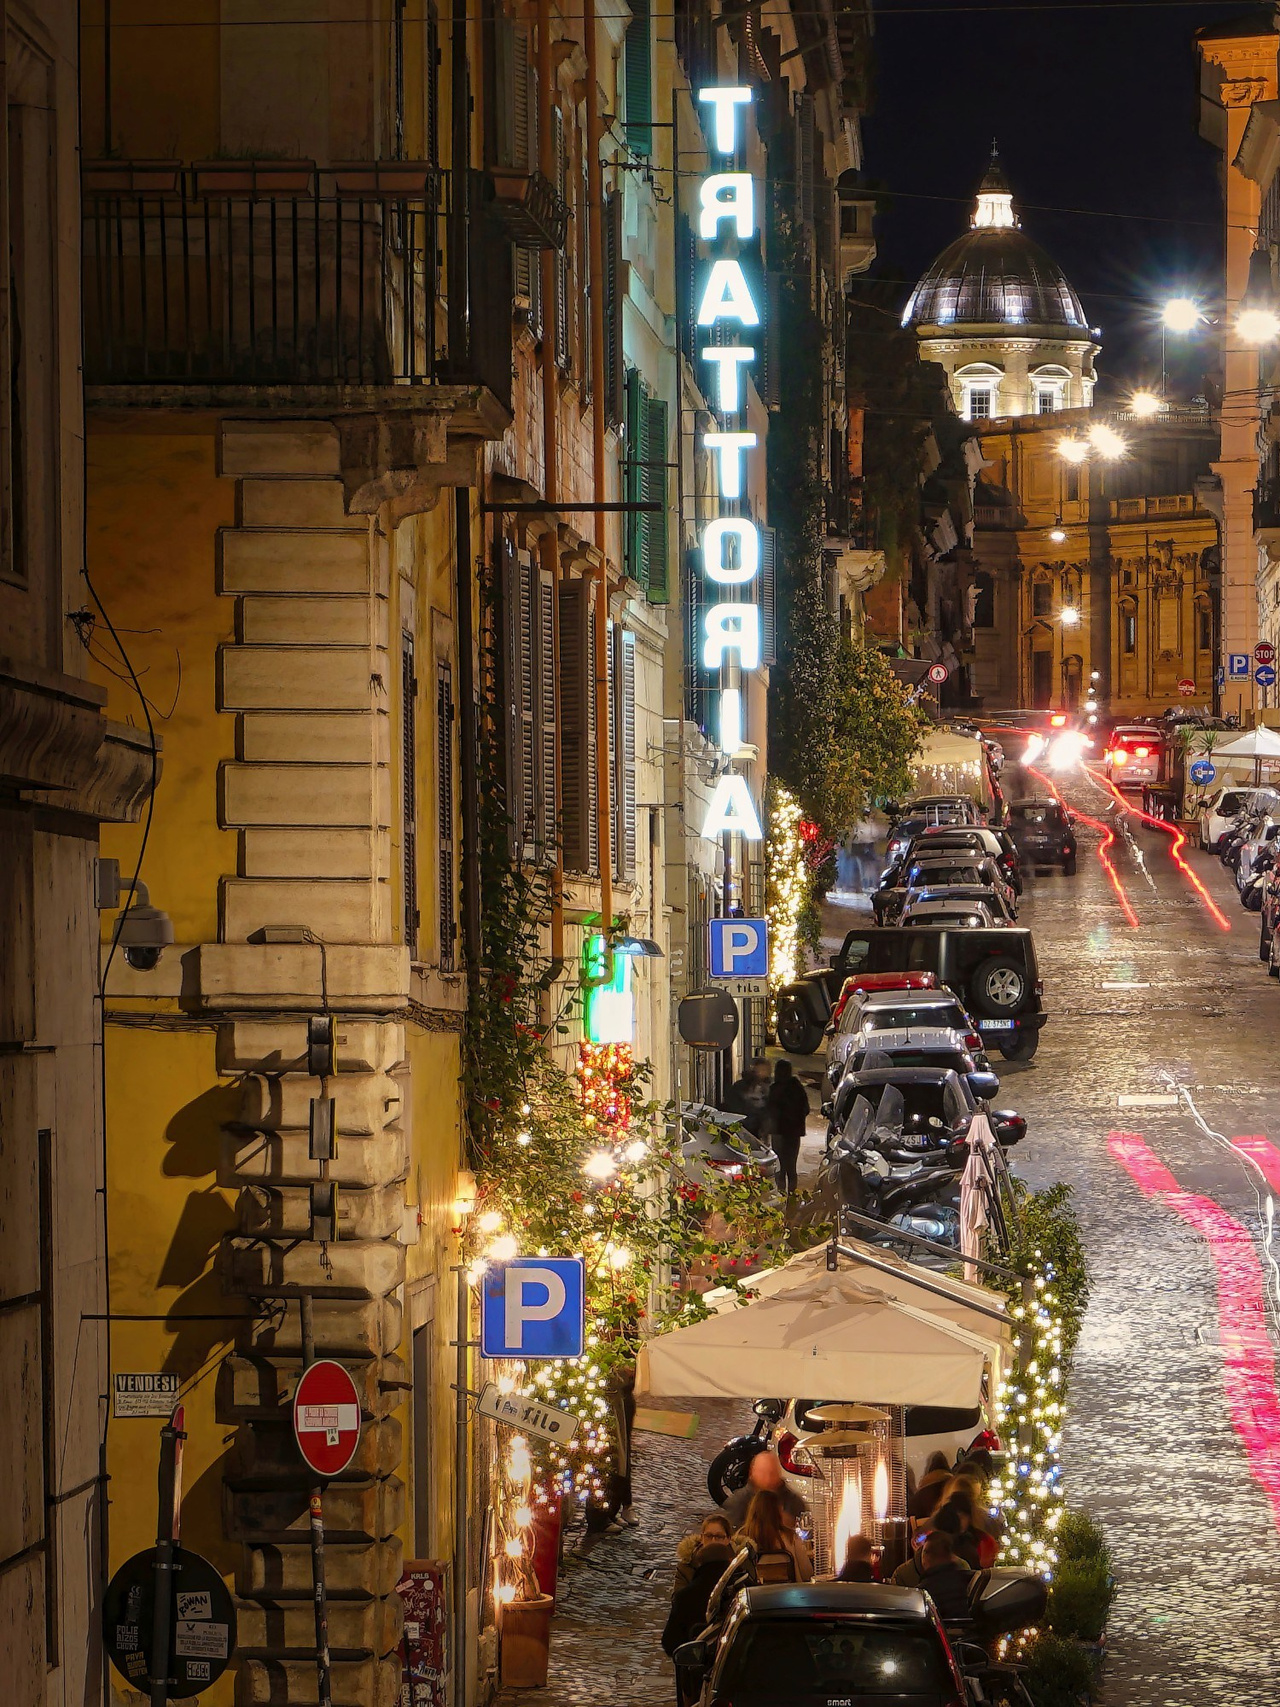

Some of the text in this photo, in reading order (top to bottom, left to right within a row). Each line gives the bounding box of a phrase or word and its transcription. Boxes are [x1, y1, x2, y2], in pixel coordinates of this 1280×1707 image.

[1255, 650, 1275, 659] STOP
[1233, 656, 1246, 673] P
[722, 924, 758, 972] P
[505, 1268, 566, 1349] P
[117, 1375, 175, 1391] VENDESI
[827, 1698, 852, 1706] smart
